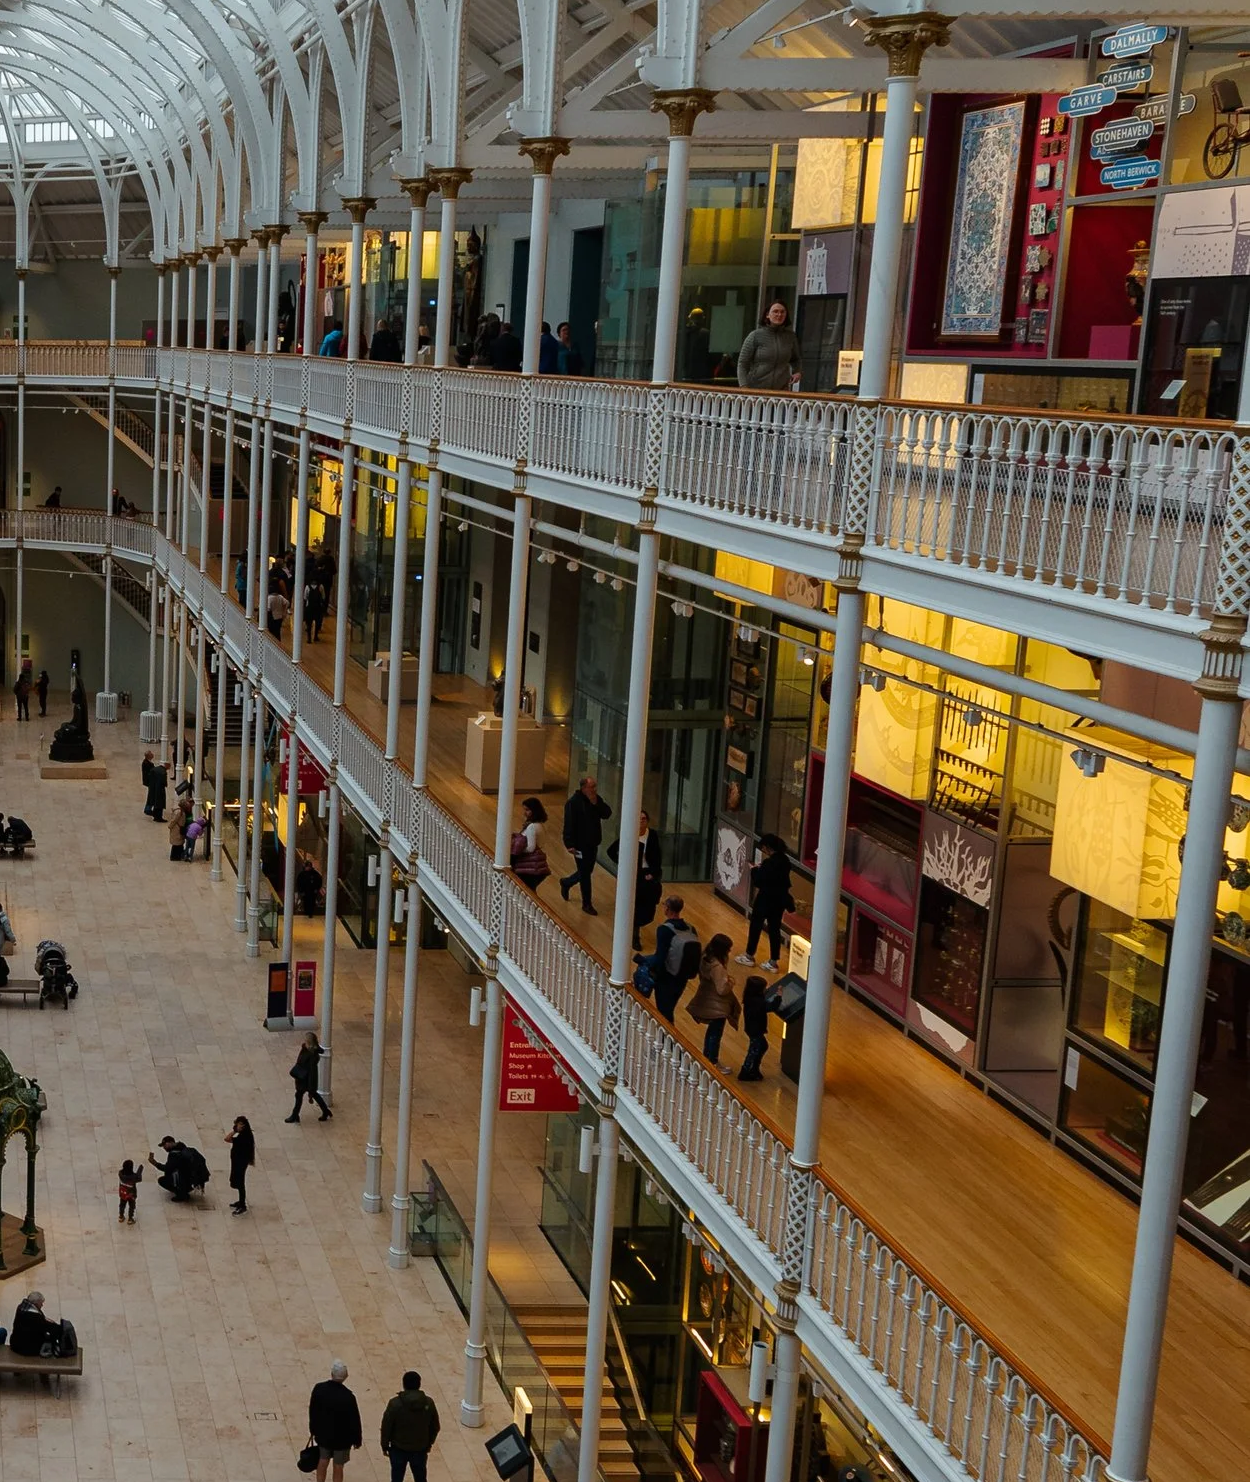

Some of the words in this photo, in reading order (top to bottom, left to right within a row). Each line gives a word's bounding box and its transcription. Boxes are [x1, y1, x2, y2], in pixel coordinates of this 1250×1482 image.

[1110, 29, 1159, 52] DALMALLY
[1102, 68, 1146, 86] CARSTAIRS
[1069, 92, 1103, 109] GARVE
[1140, 99, 1186, 119] BARAE
[1094, 124, 1149, 144] STONEHAVEN
[1103, 167, 1127, 181] NORTH
[1127, 164, 1156, 178] BERWICK
[508, 1062, 525, 1070] Shop
[510, 1091, 532, 1101] Exit
